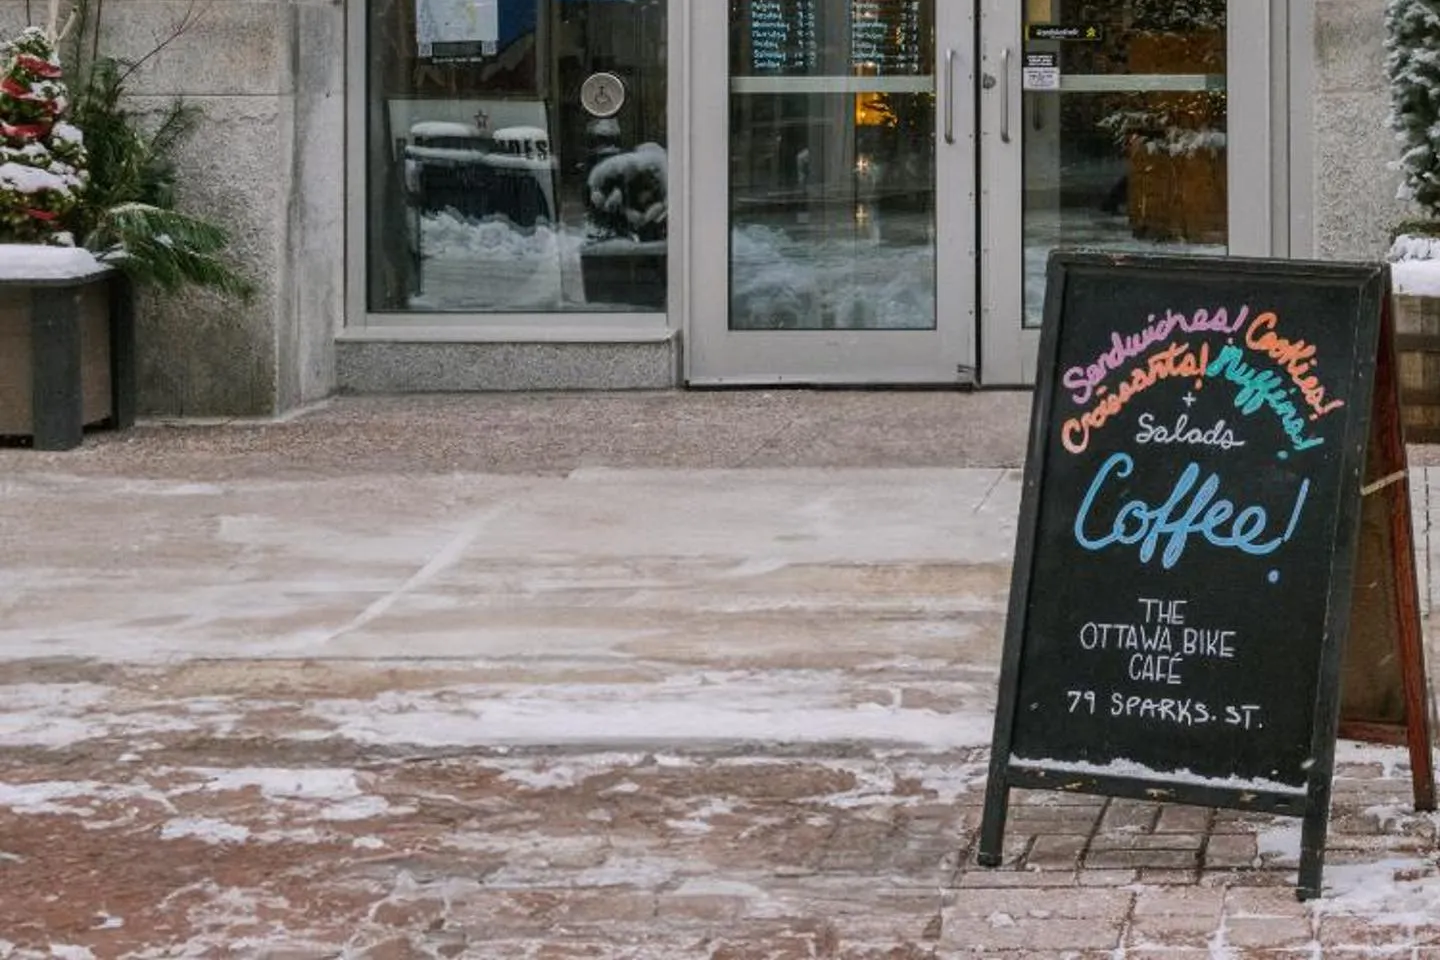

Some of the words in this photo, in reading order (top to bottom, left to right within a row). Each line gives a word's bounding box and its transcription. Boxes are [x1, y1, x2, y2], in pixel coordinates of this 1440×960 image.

[1135, 412, 1246, 451] Salads
[1074, 451, 1311, 583] Coffee!
[1137, 598, 1188, 626] THE
[1079, 621, 1173, 653] OTTAWA
[1182, 627, 1237, 658] BIKE
[1128, 650, 1184, 685] CAFÉ
[1066, 690, 1096, 715] 79
[1224, 704, 1264, 731] ST.
